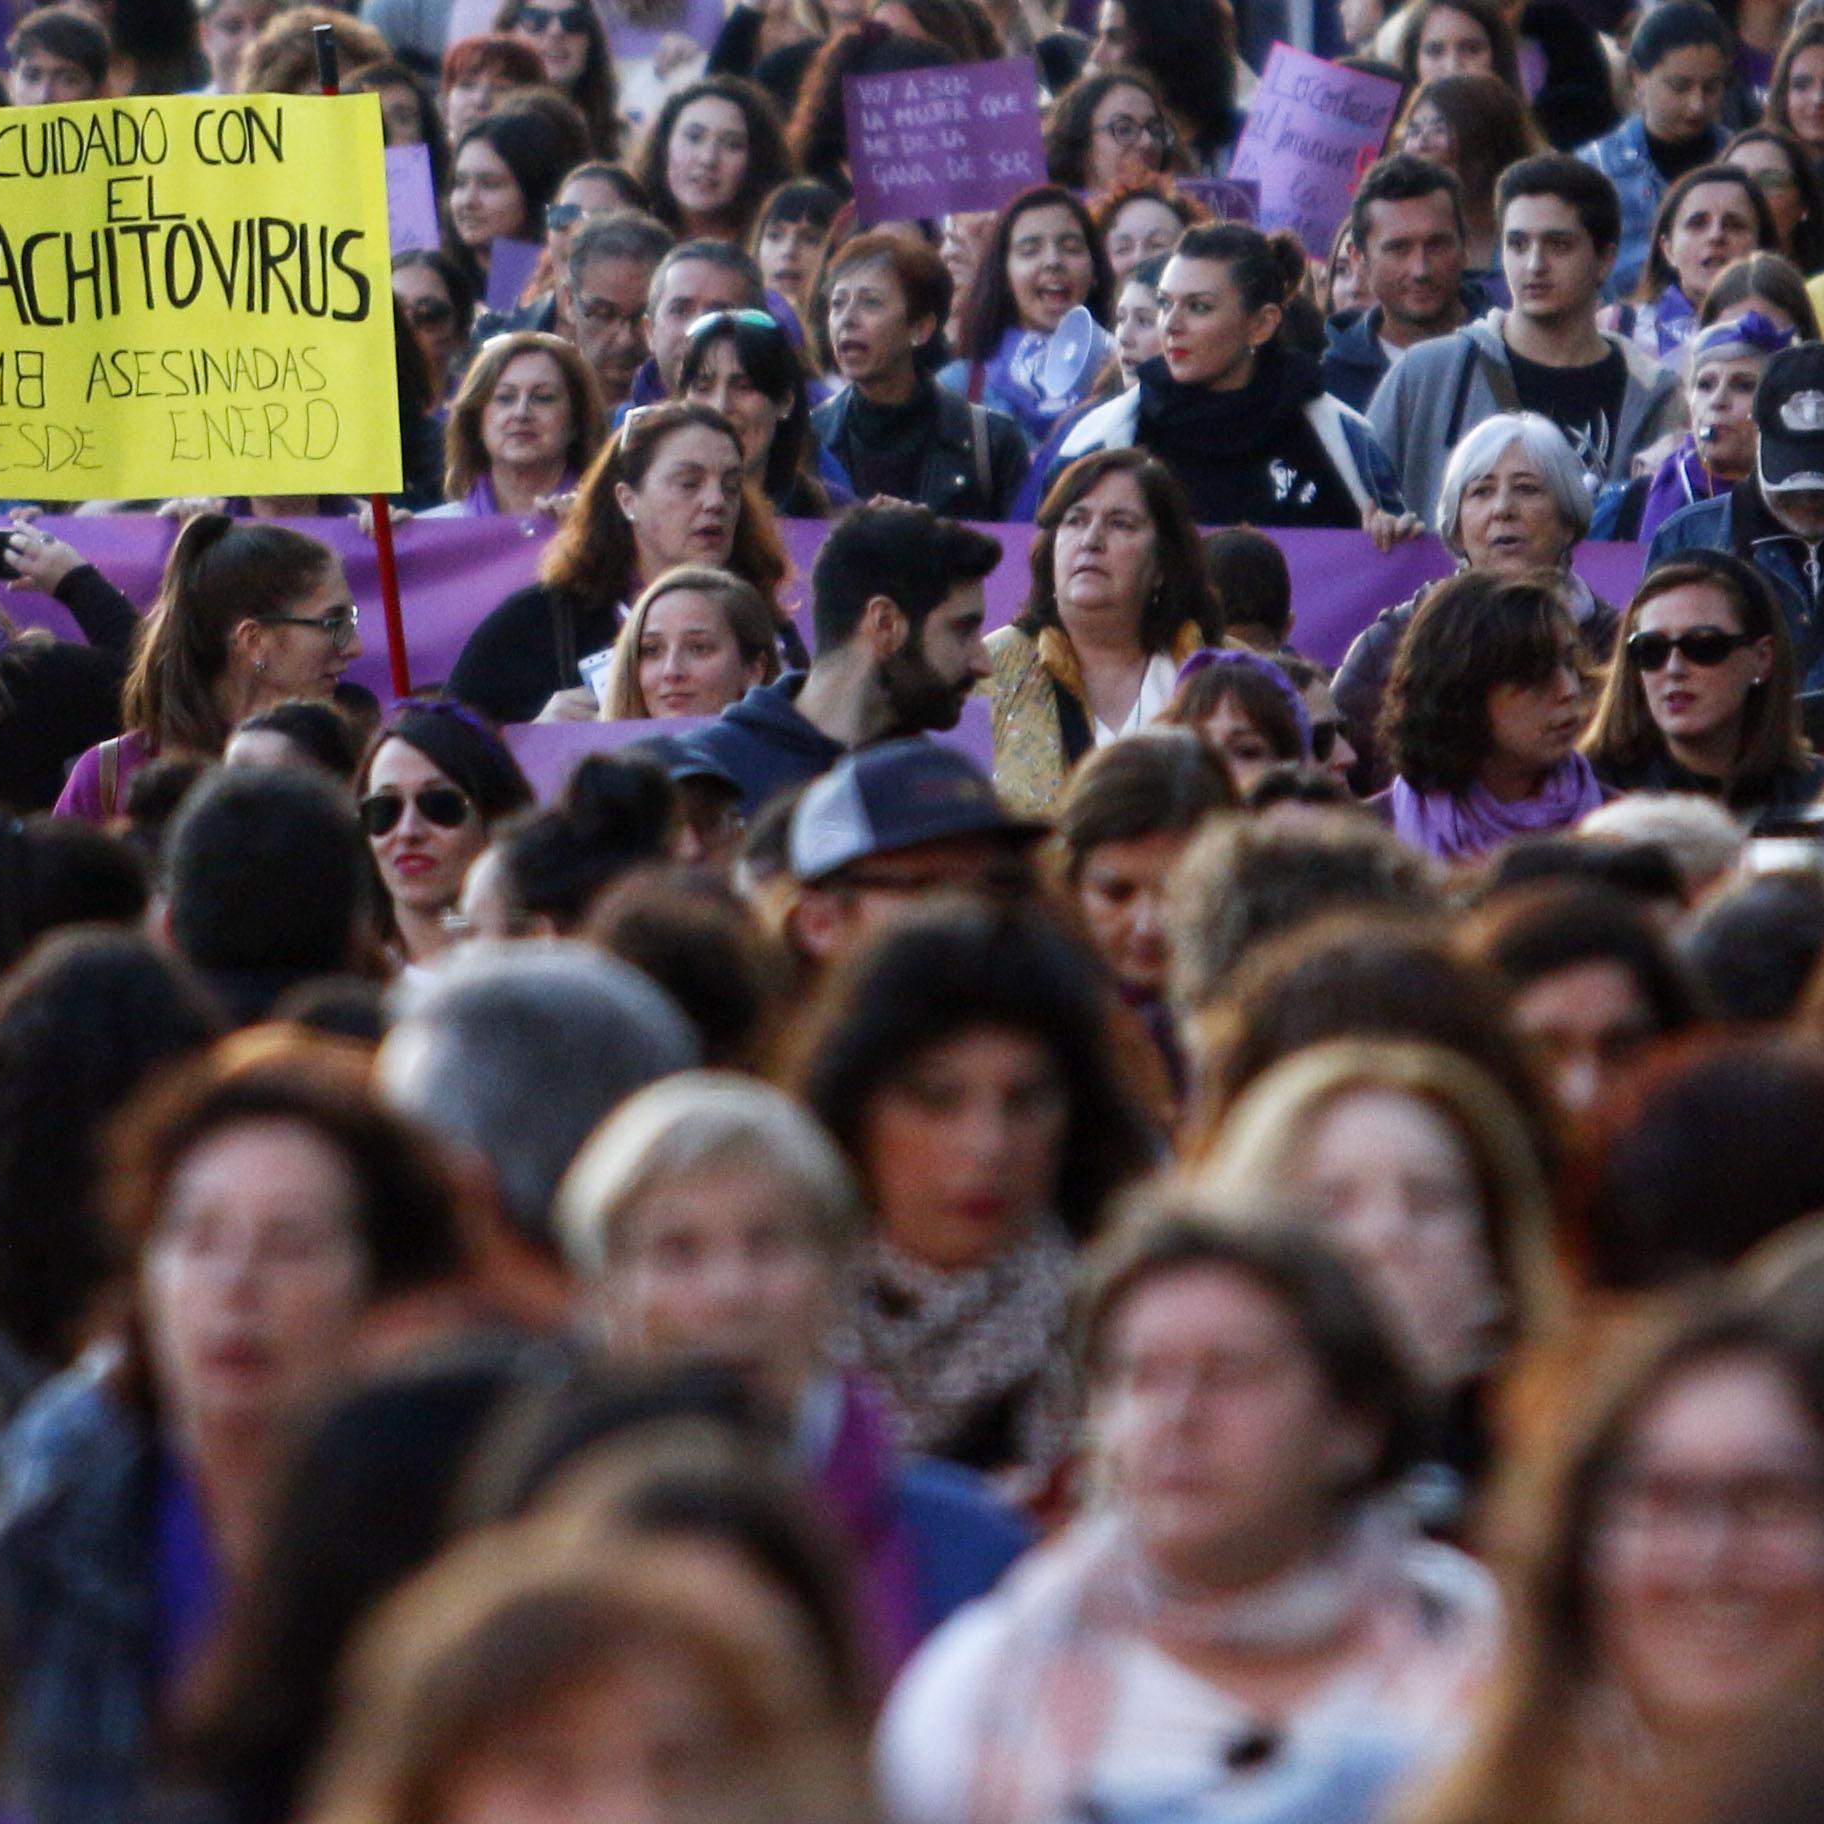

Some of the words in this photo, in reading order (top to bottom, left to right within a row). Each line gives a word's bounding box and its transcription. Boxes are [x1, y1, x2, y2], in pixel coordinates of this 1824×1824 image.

[193, 104, 286, 167] CON
[106, 174, 188, 225] EL
[86, 345, 329, 404] ASESINADAS
[169, 397, 341, 463] ENERO
